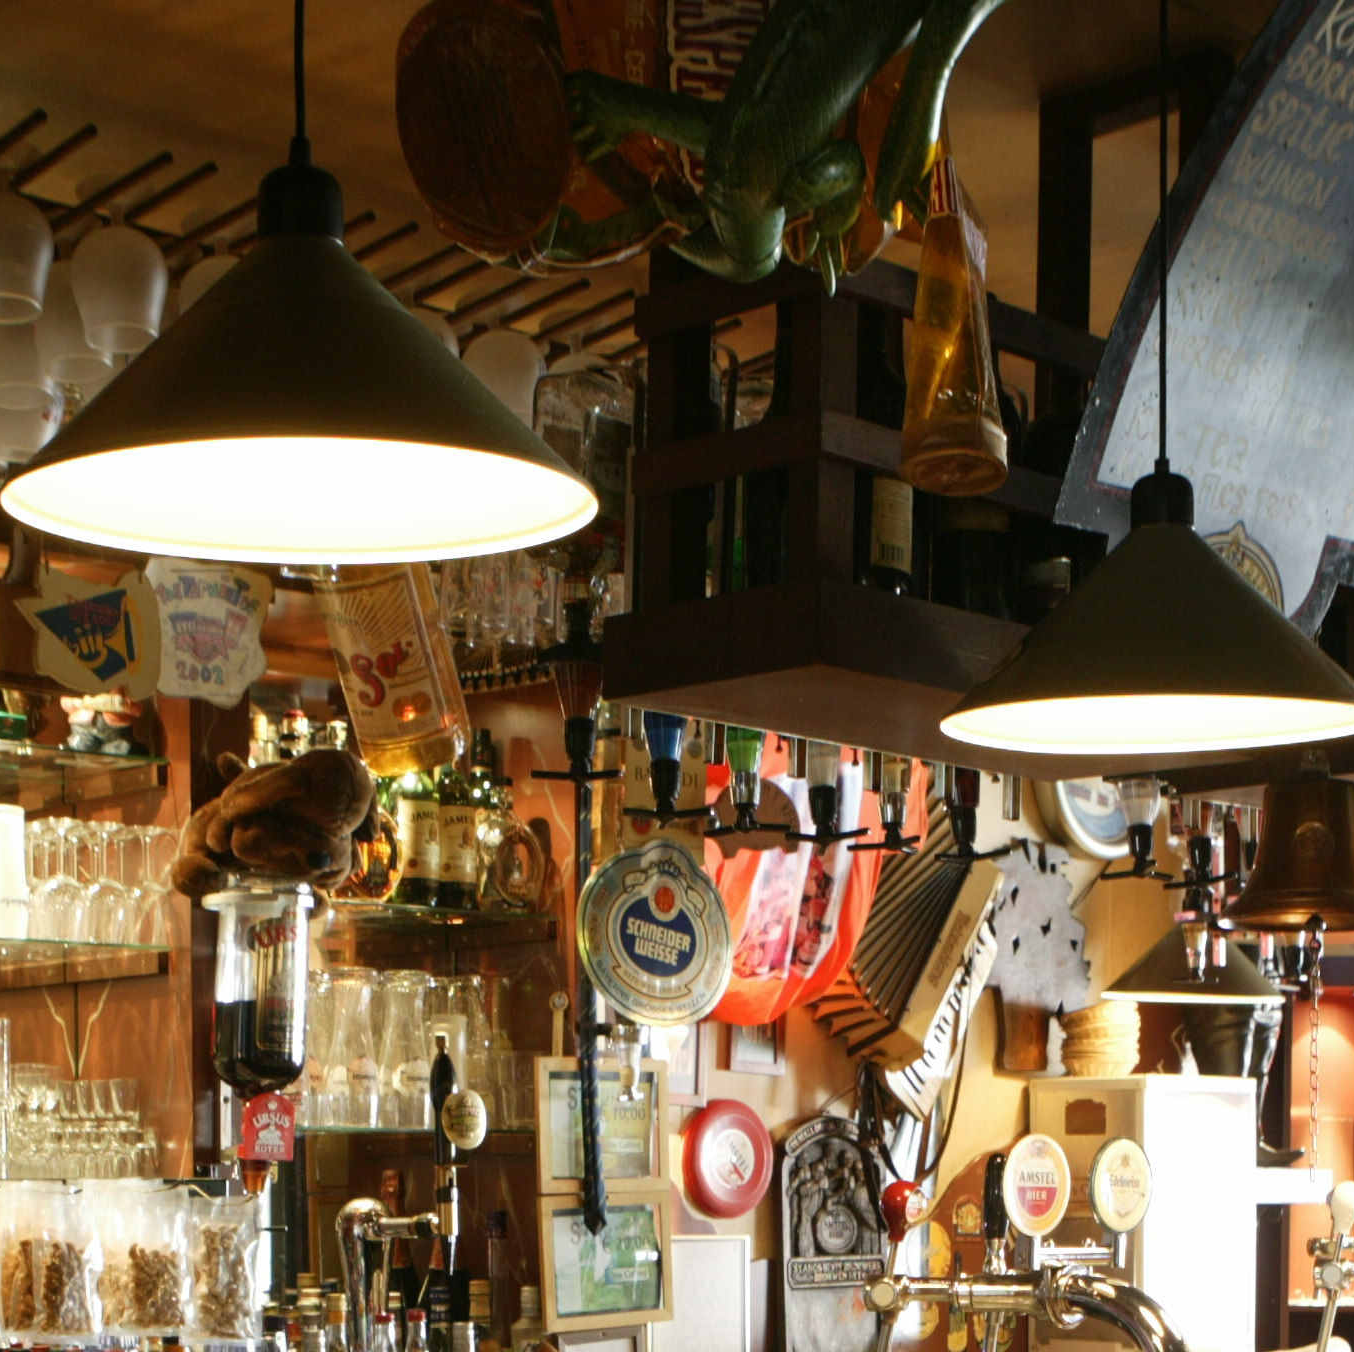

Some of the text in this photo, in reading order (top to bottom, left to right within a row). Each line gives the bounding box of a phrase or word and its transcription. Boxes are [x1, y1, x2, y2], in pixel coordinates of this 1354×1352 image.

[175, 659, 226, 686] 2002
[625, 915, 692, 954] SCHNEIDER
[633, 937, 680, 967] WEISSE
[252, 1112, 292, 1130] URSUS
[1018, 1170, 1057, 1186] AMSTEL
[1025, 1190, 1048, 1201] BIER
